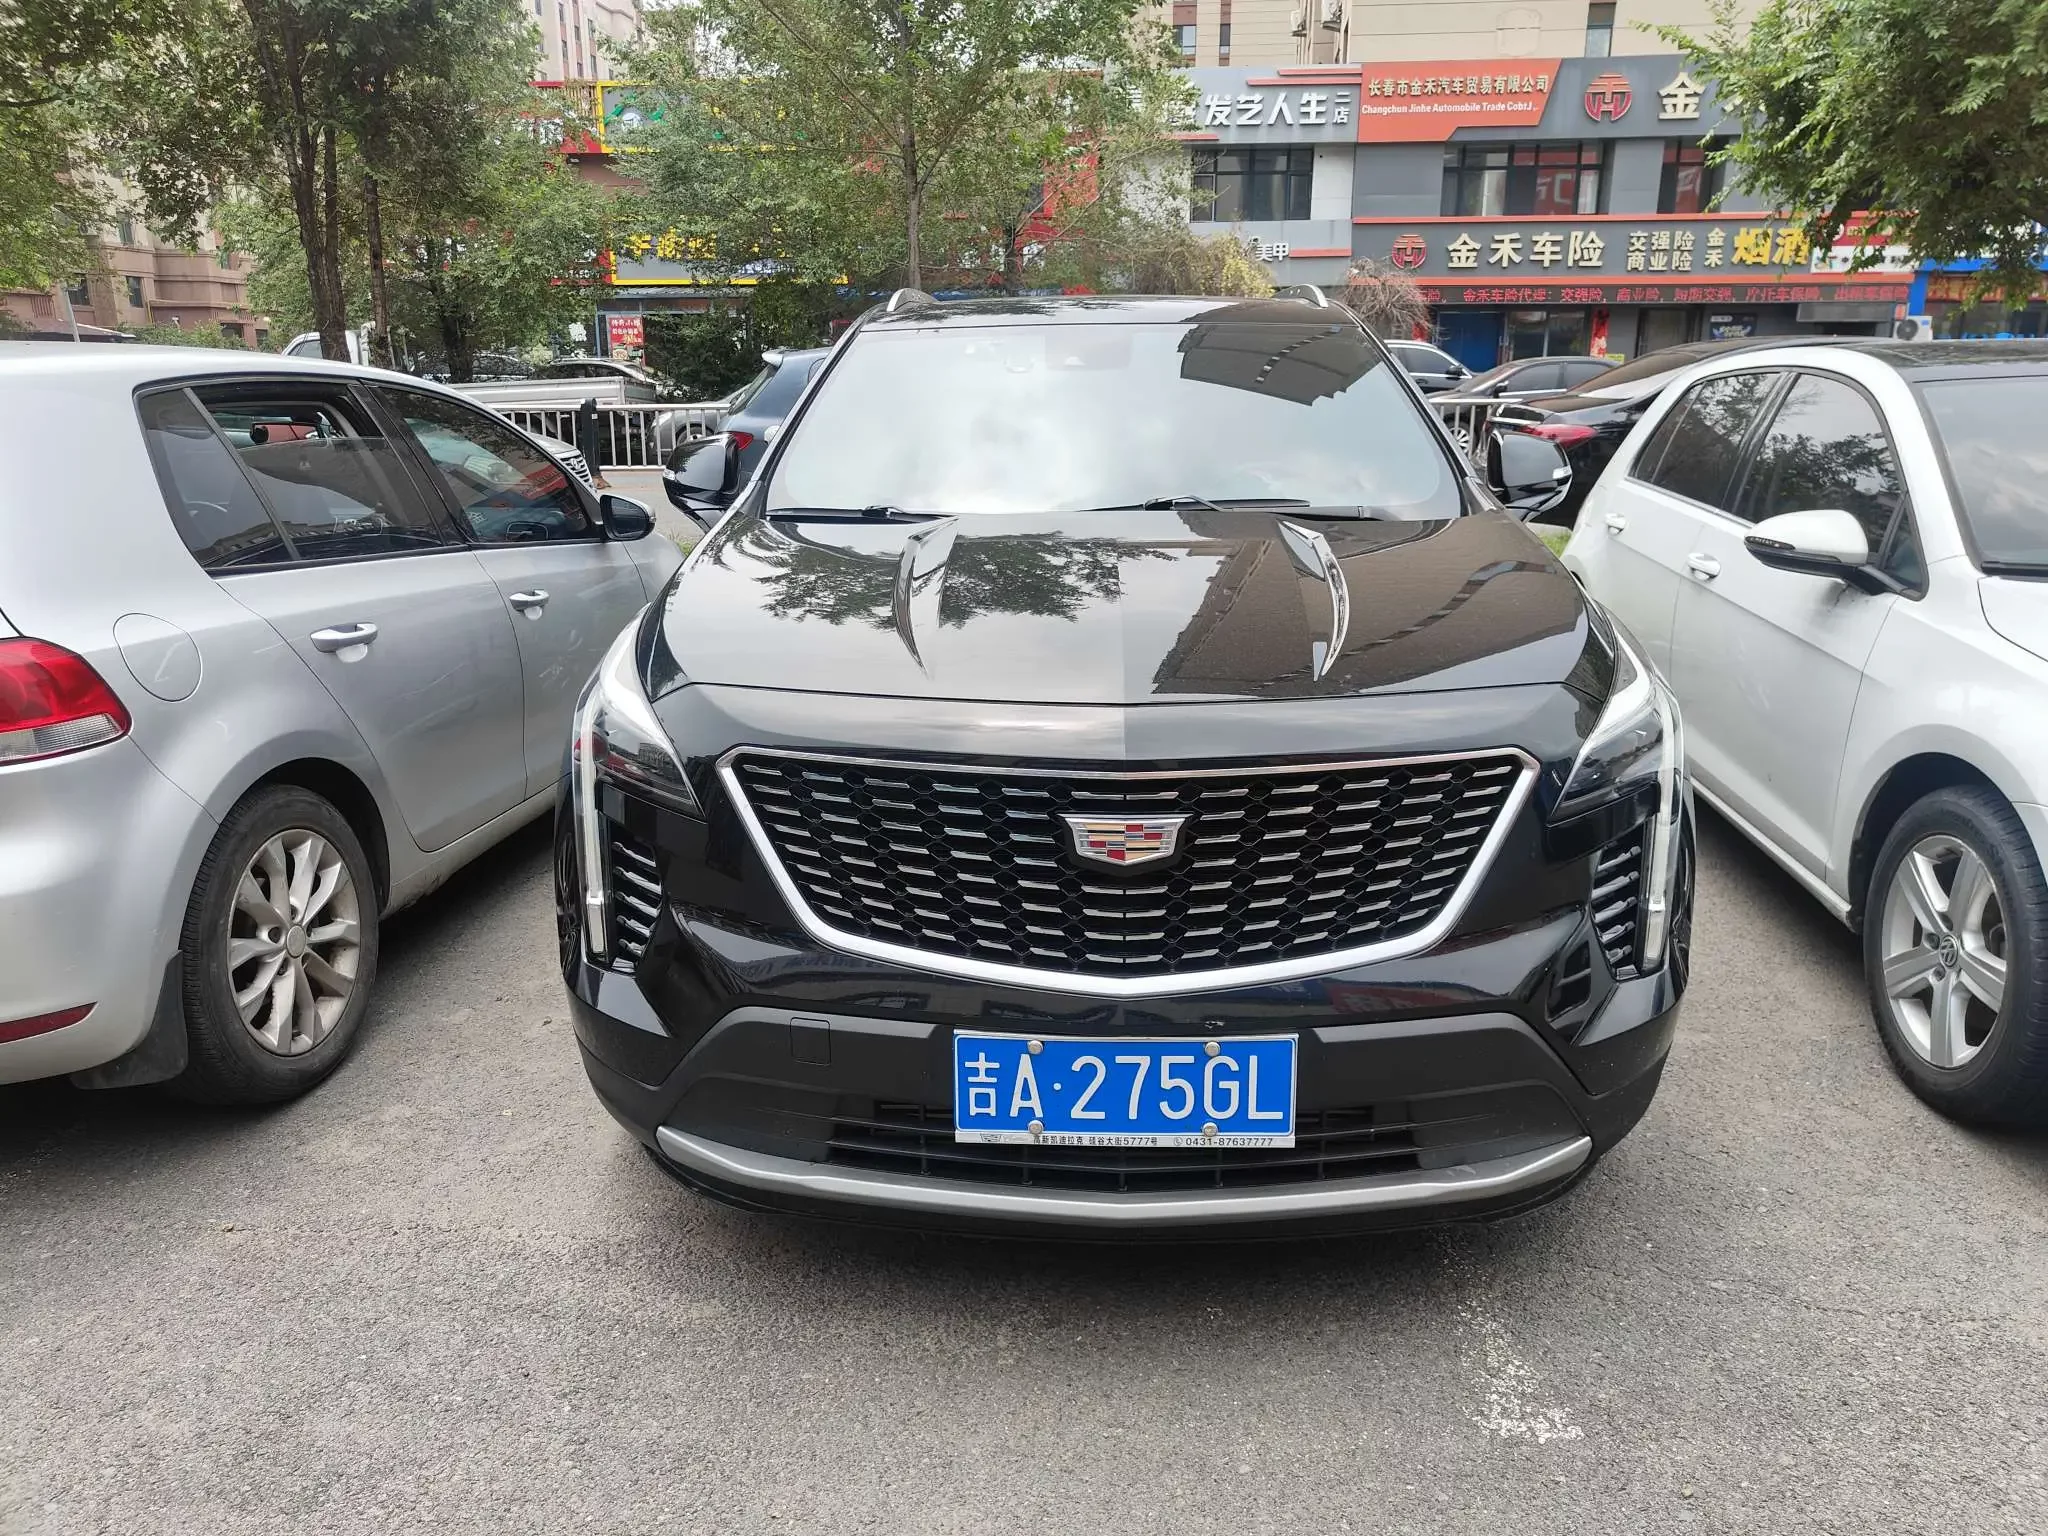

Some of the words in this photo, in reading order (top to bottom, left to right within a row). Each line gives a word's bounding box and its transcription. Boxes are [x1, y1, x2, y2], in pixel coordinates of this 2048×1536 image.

[1368, 74, 1550, 97] 长春市金禾汽车贸易有限公司
[1361, 104, 1408, 116] Changchun
[1408, 103, 1431, 113] Jinhe
[1432, 102, 1480, 113] Automobile
[1482, 102, 1505, 112] Trade
[1447, 230, 1606, 268] 金禾车险
[1627, 230, 1698, 252] 交强险
[1731, 227, 1811, 266] 烟酒
[1255, 242, 1289, 262] 美甲
[1626, 251, 1693, 272] 商业险
[1185, 1137, 1274, 1147] 0431-87637777
